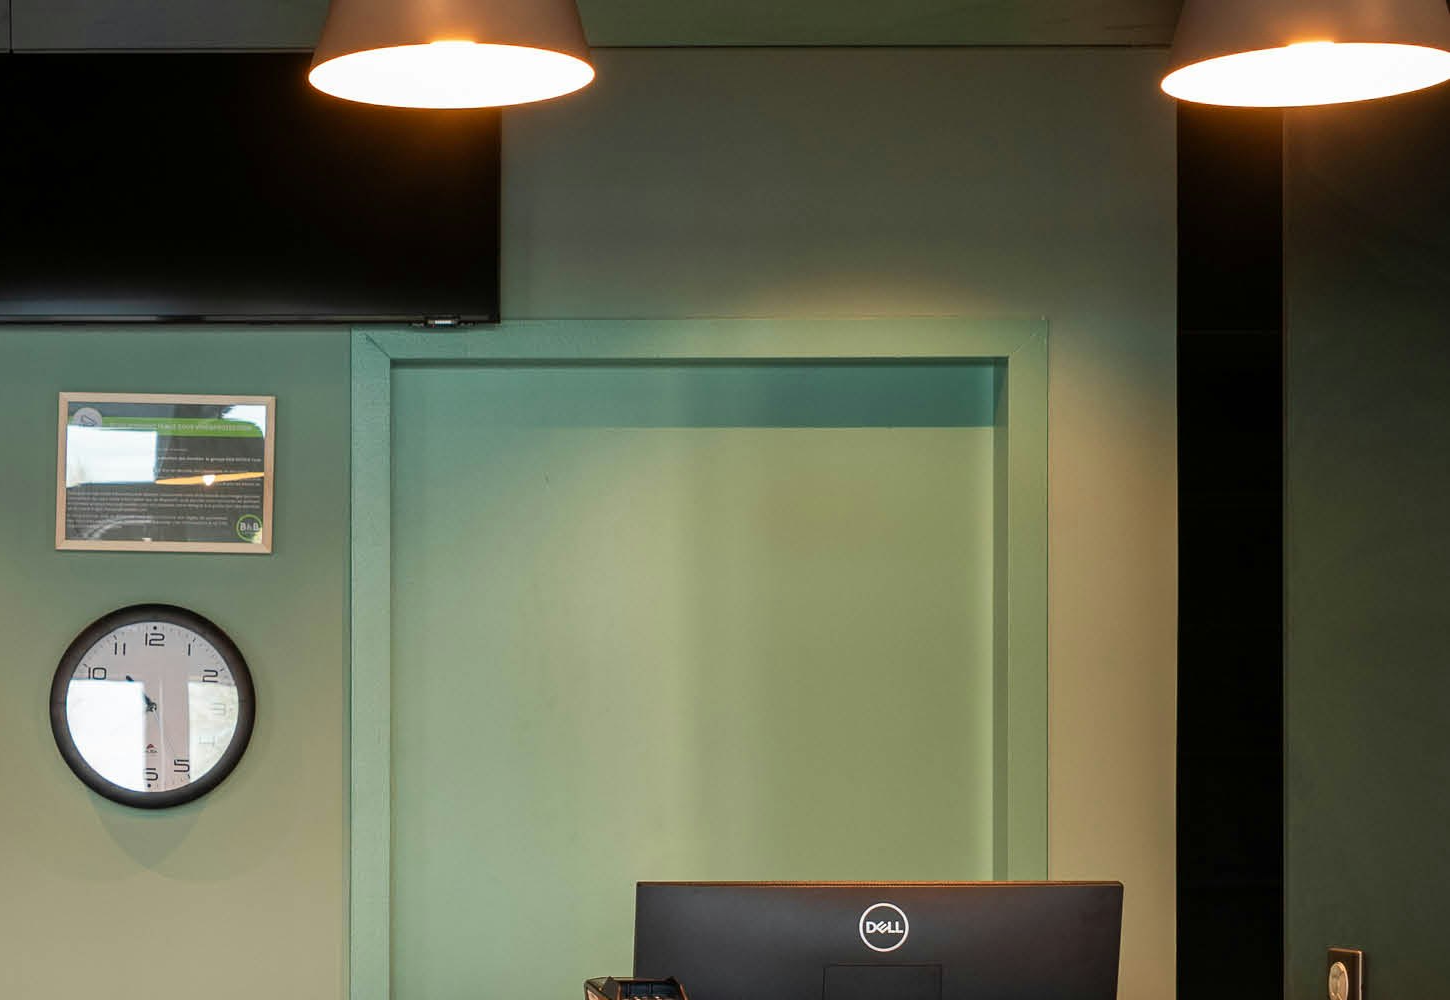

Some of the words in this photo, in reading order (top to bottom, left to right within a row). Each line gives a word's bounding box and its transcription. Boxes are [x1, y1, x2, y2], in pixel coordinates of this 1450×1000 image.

[144, 632, 165, 647] 12
[114, 642, 126, 656] 11
[87, 667, 107, 681] 10
[202, 669, 219, 683] 2
[209, 702, 227, 716] 3
[173, 759, 190, 773] 5
[866, 921, 904, 934] DELL
